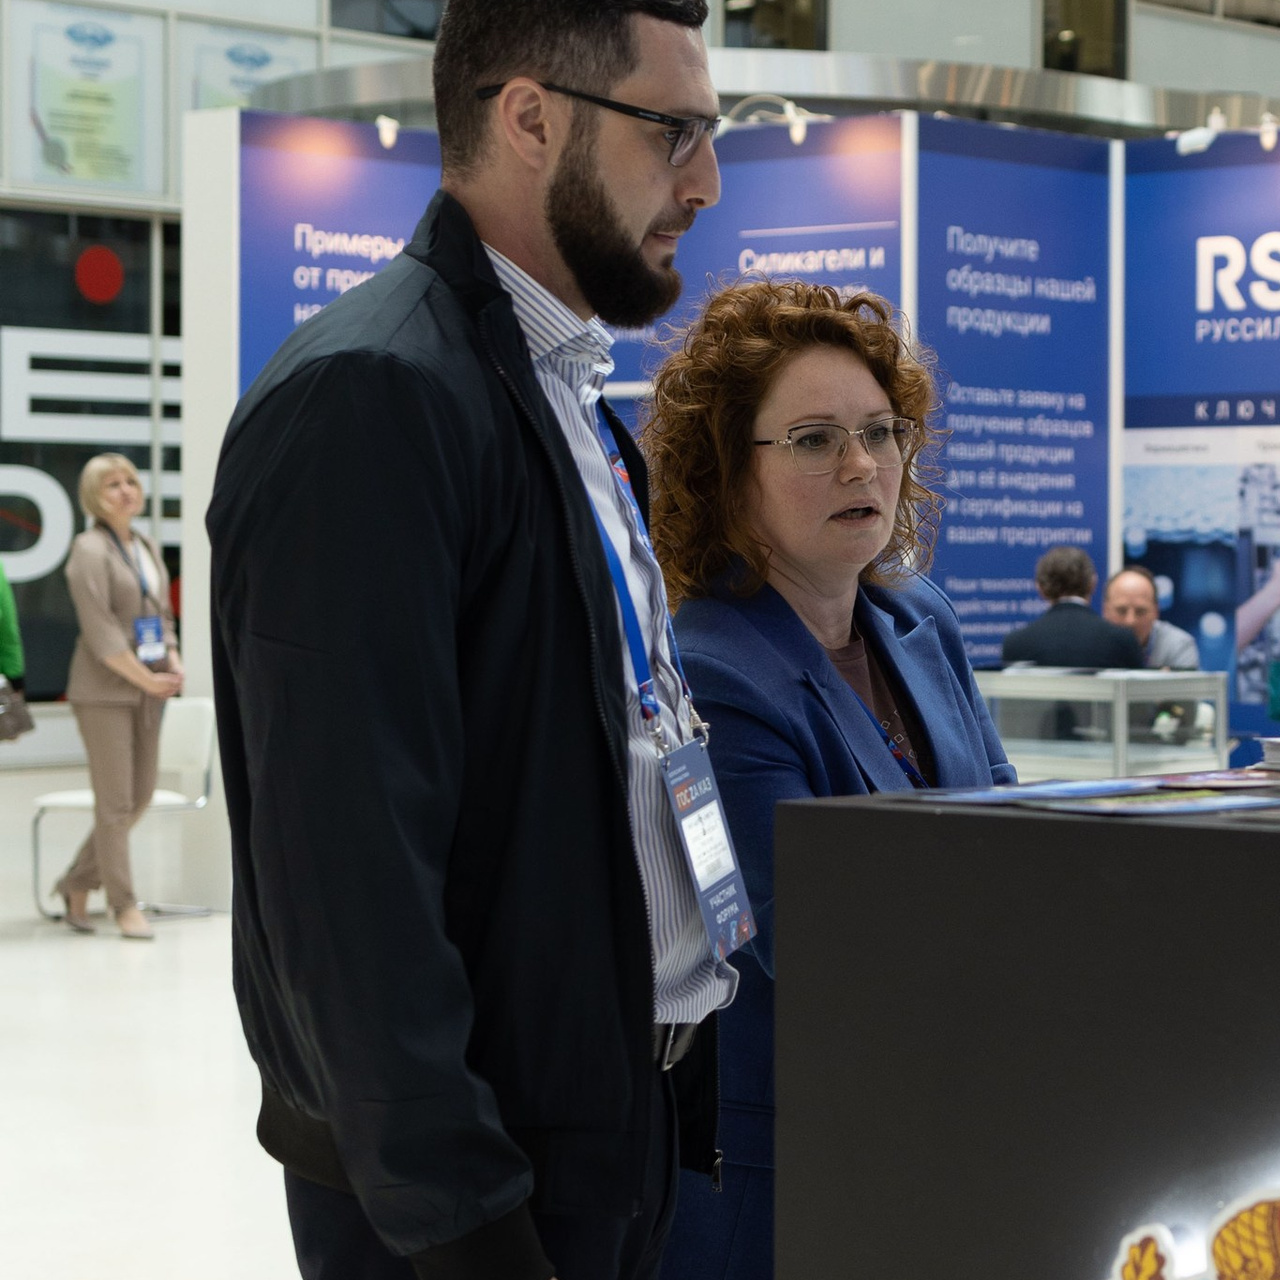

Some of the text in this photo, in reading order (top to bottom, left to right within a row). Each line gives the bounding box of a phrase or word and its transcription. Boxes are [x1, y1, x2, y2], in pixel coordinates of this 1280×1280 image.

[738, 246, 886, 274] Силикагели и
[946, 225, 1040, 263] Получите
[293, 266, 323, 291] от
[946, 264, 1097, 303] образцы нашей
